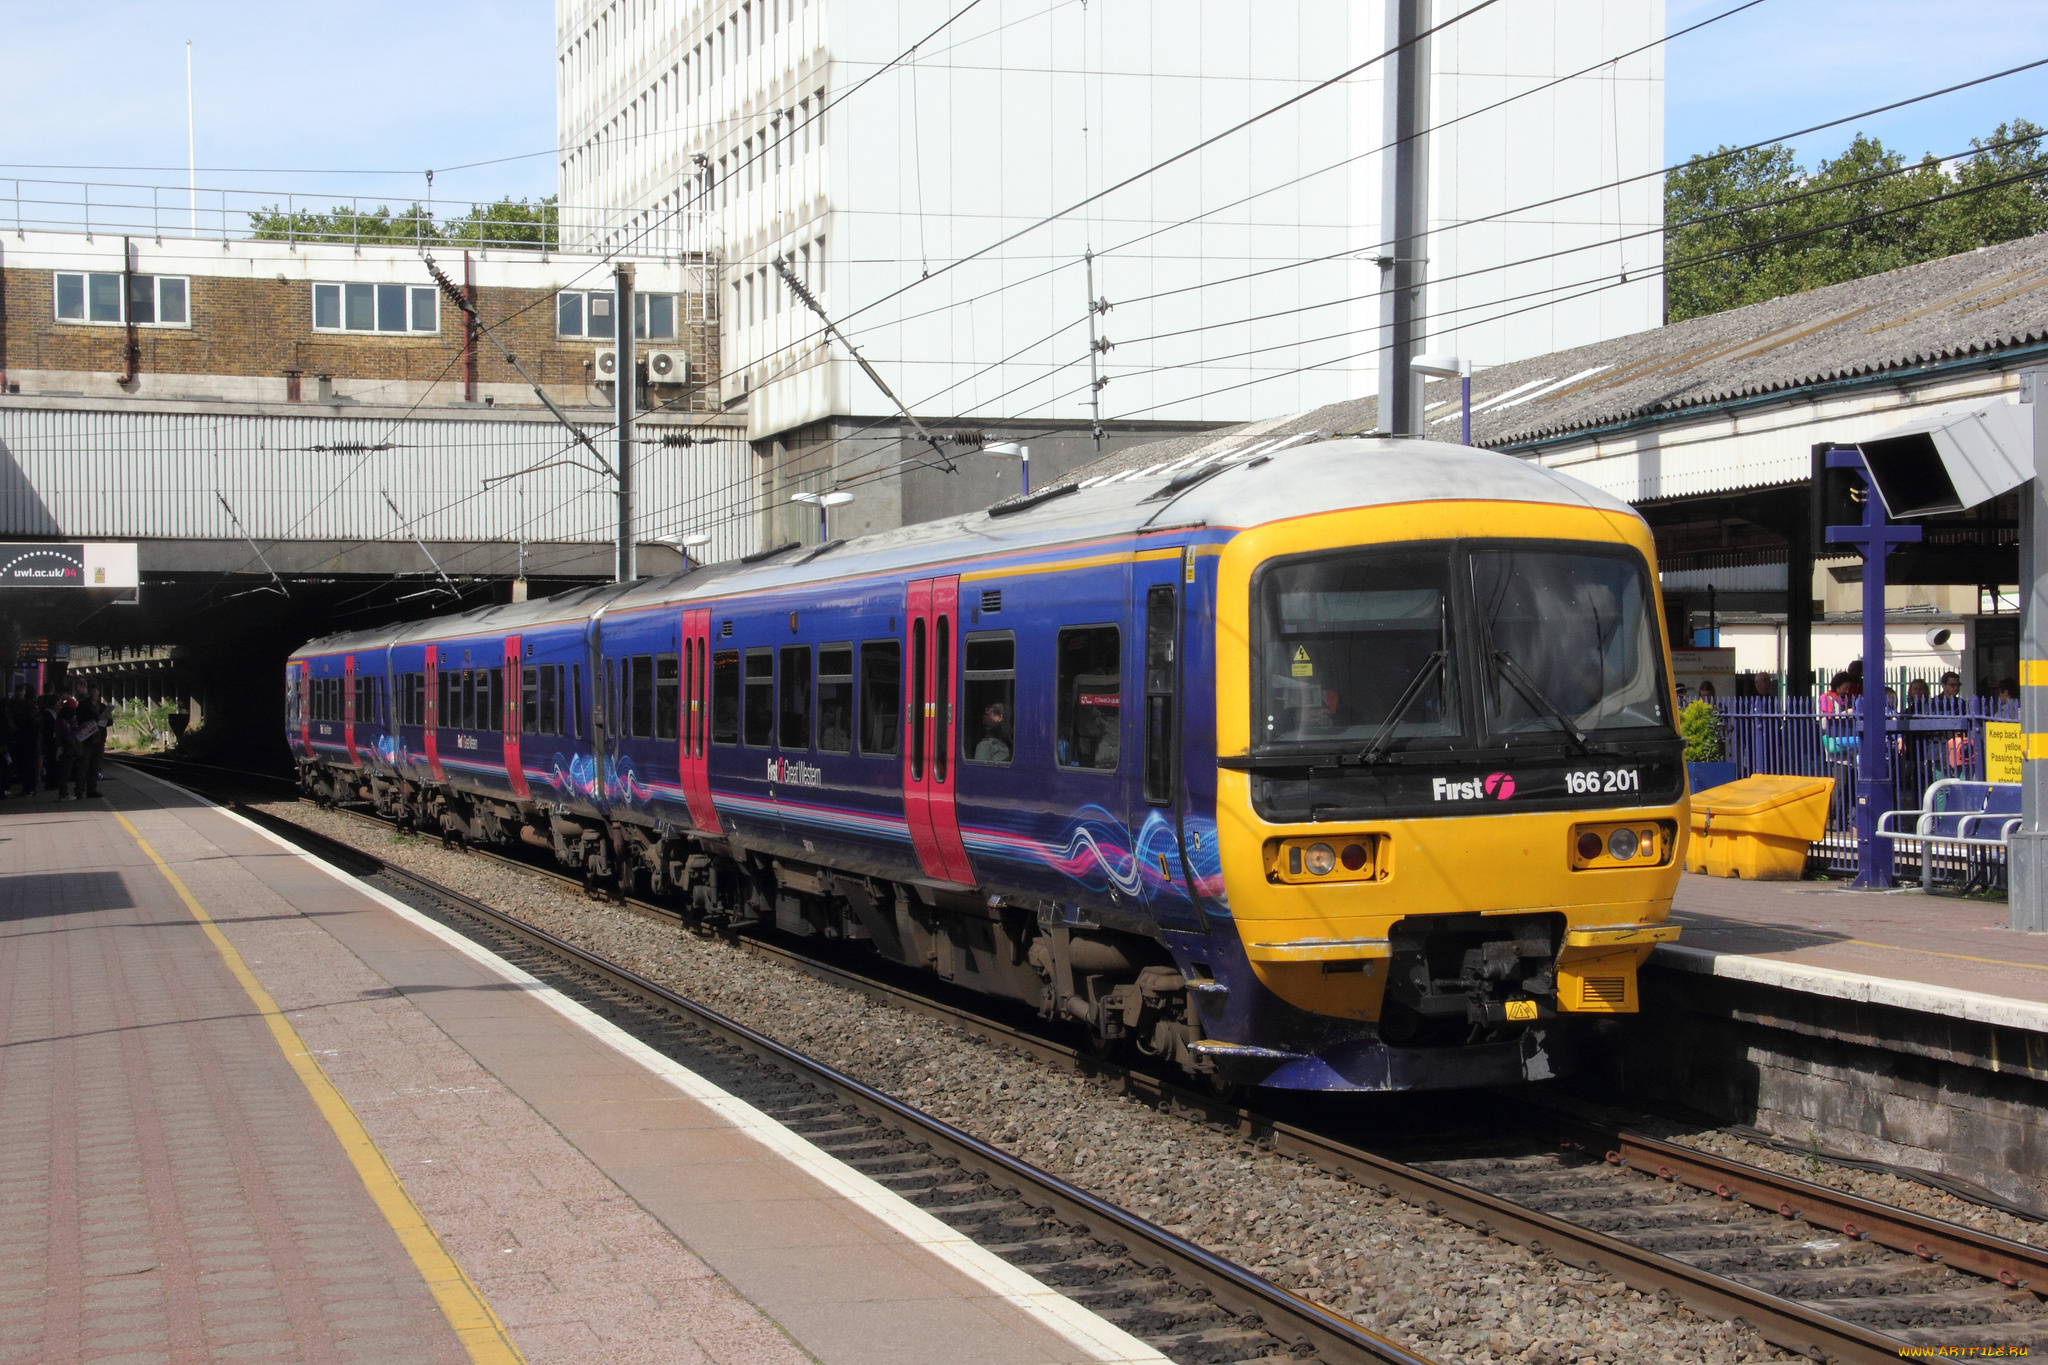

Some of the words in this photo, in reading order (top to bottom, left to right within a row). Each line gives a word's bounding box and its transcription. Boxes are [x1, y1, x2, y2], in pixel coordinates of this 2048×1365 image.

[14, 568, 77, 577] uwl.ac.uk/94
[1989, 730, 2003, 740] Keep
[2005, 730, 2018, 739] back
[1991, 752, 2013, 764] Passing
[1432, 777, 1483, 800] First
